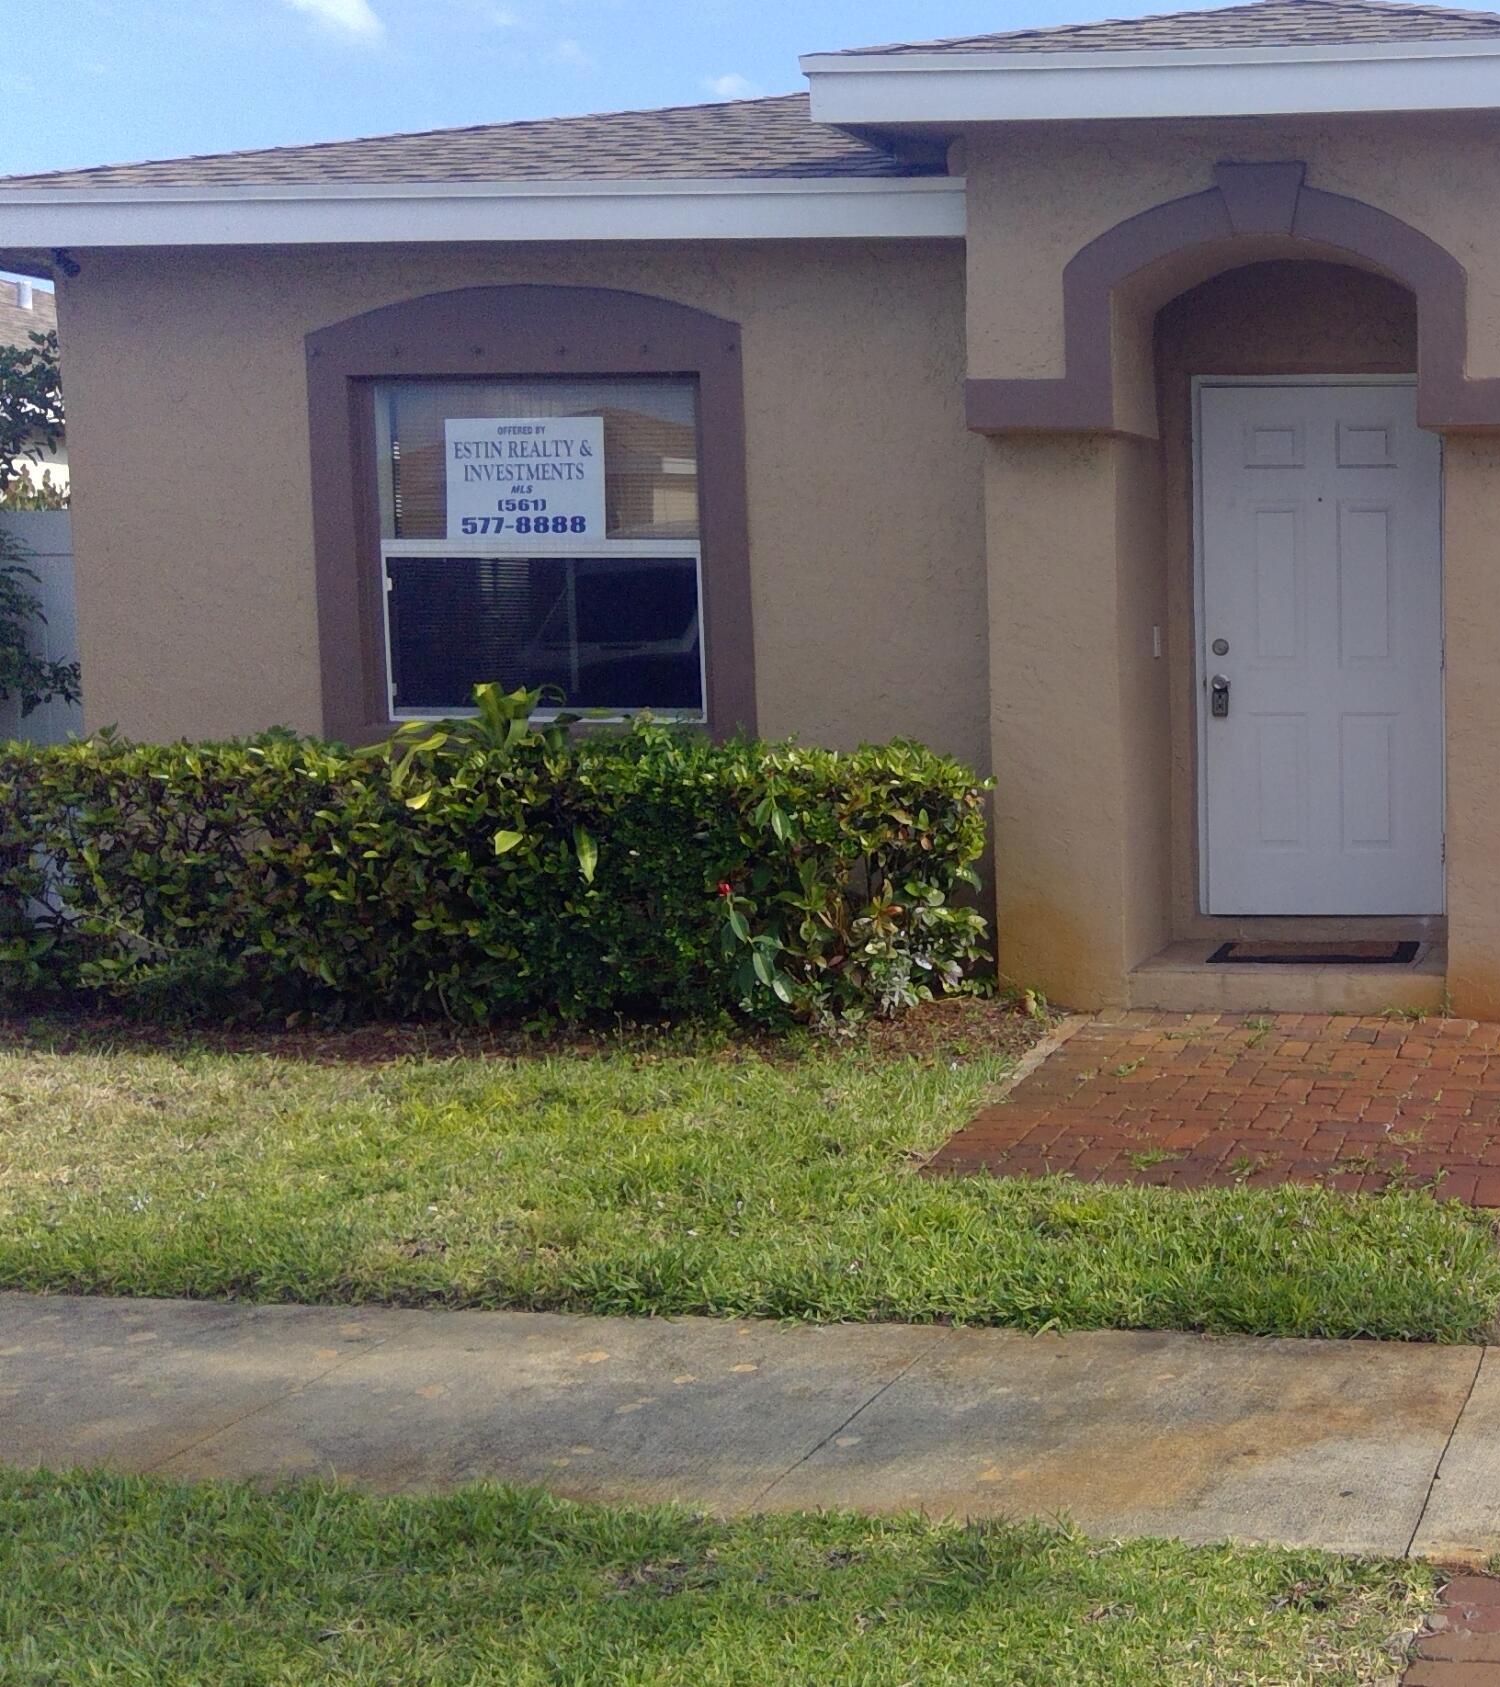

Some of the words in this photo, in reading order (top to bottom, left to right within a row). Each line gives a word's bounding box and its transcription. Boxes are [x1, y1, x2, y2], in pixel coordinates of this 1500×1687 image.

[497, 426, 533, 435] OFFERED
[535, 426, 546, 435] BY
[453, 441, 503, 459] ESTIN
[508, 440, 574, 458] REALTY
[579, 440, 593, 457] &
[464, 463, 585, 482] INVESTMENTS
[511, 485, 534, 495] MLS
[497, 499, 547, 512] (561)
[461, 516, 587, 534] 577-8888
